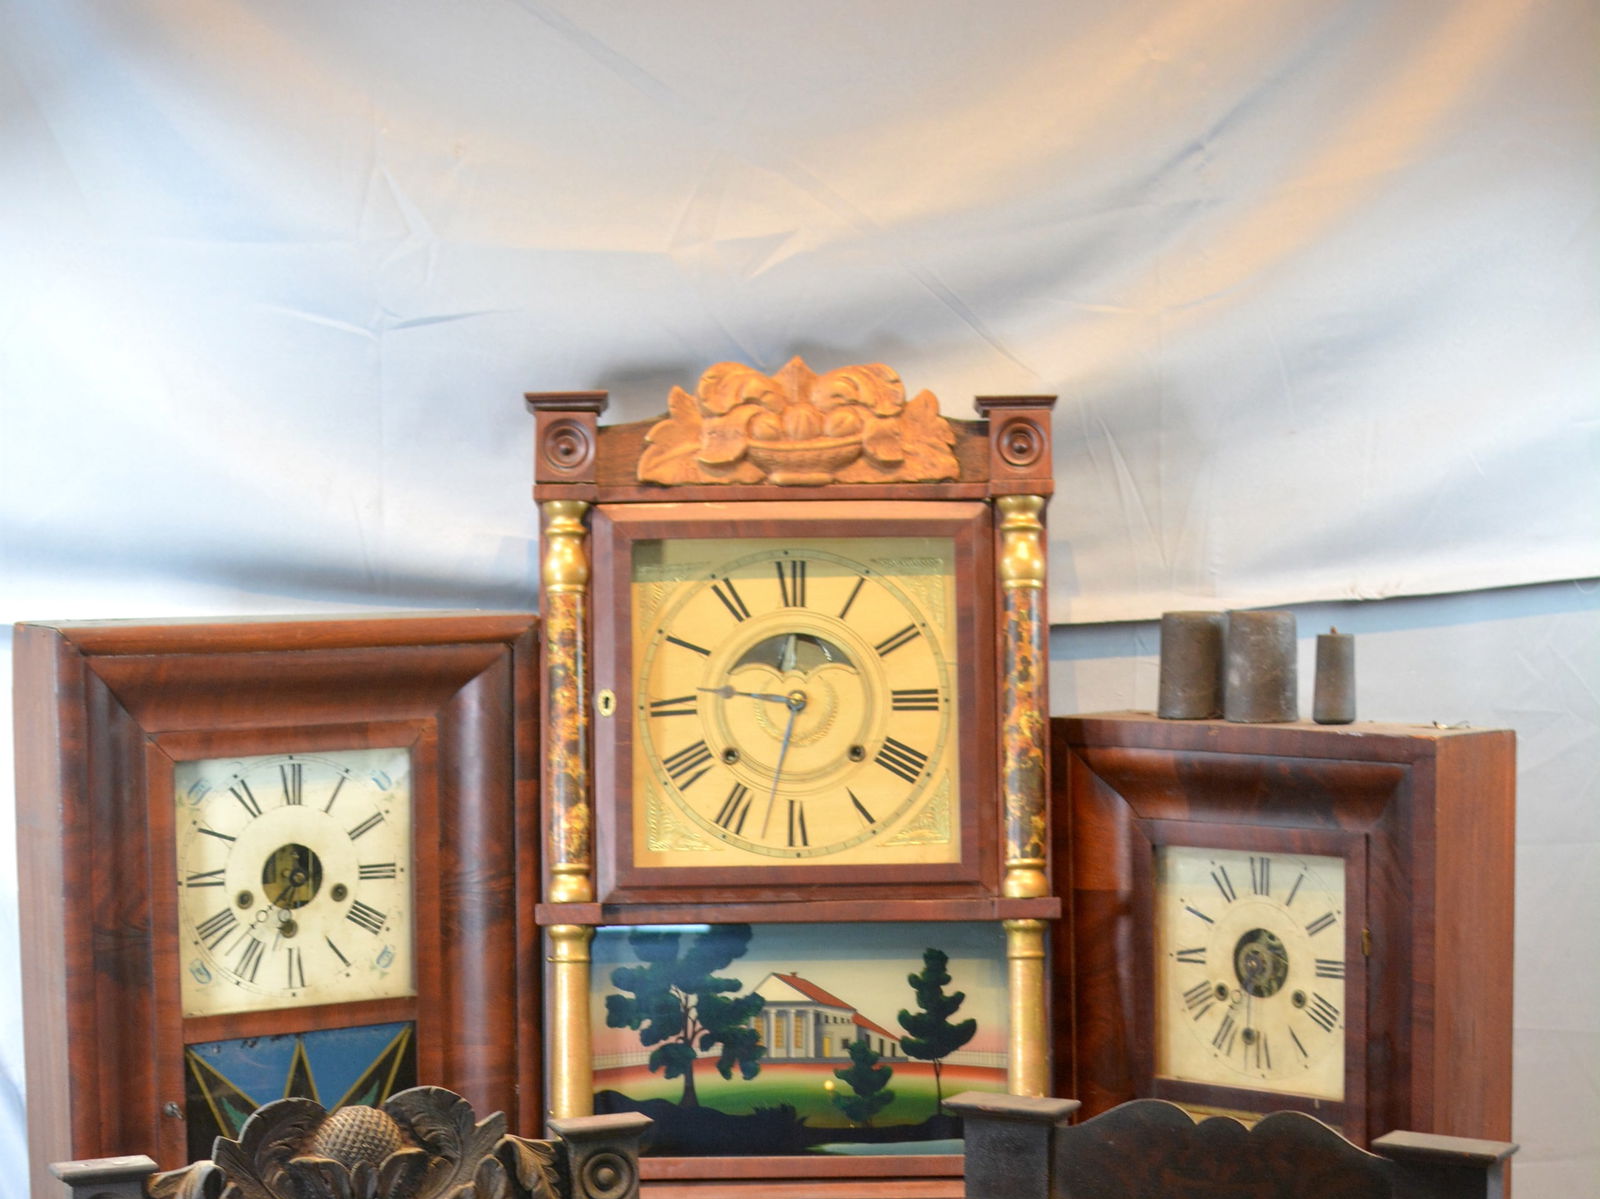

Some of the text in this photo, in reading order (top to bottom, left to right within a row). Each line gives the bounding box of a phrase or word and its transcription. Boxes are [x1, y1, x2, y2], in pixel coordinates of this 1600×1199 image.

[839, 576, 866, 619] I
[873, 623, 922, 657] II
[892, 688, 939, 711] III
[323, 775, 347, 815] I
[347, 811, 386, 841] II
[358, 862, 397, 880] III
